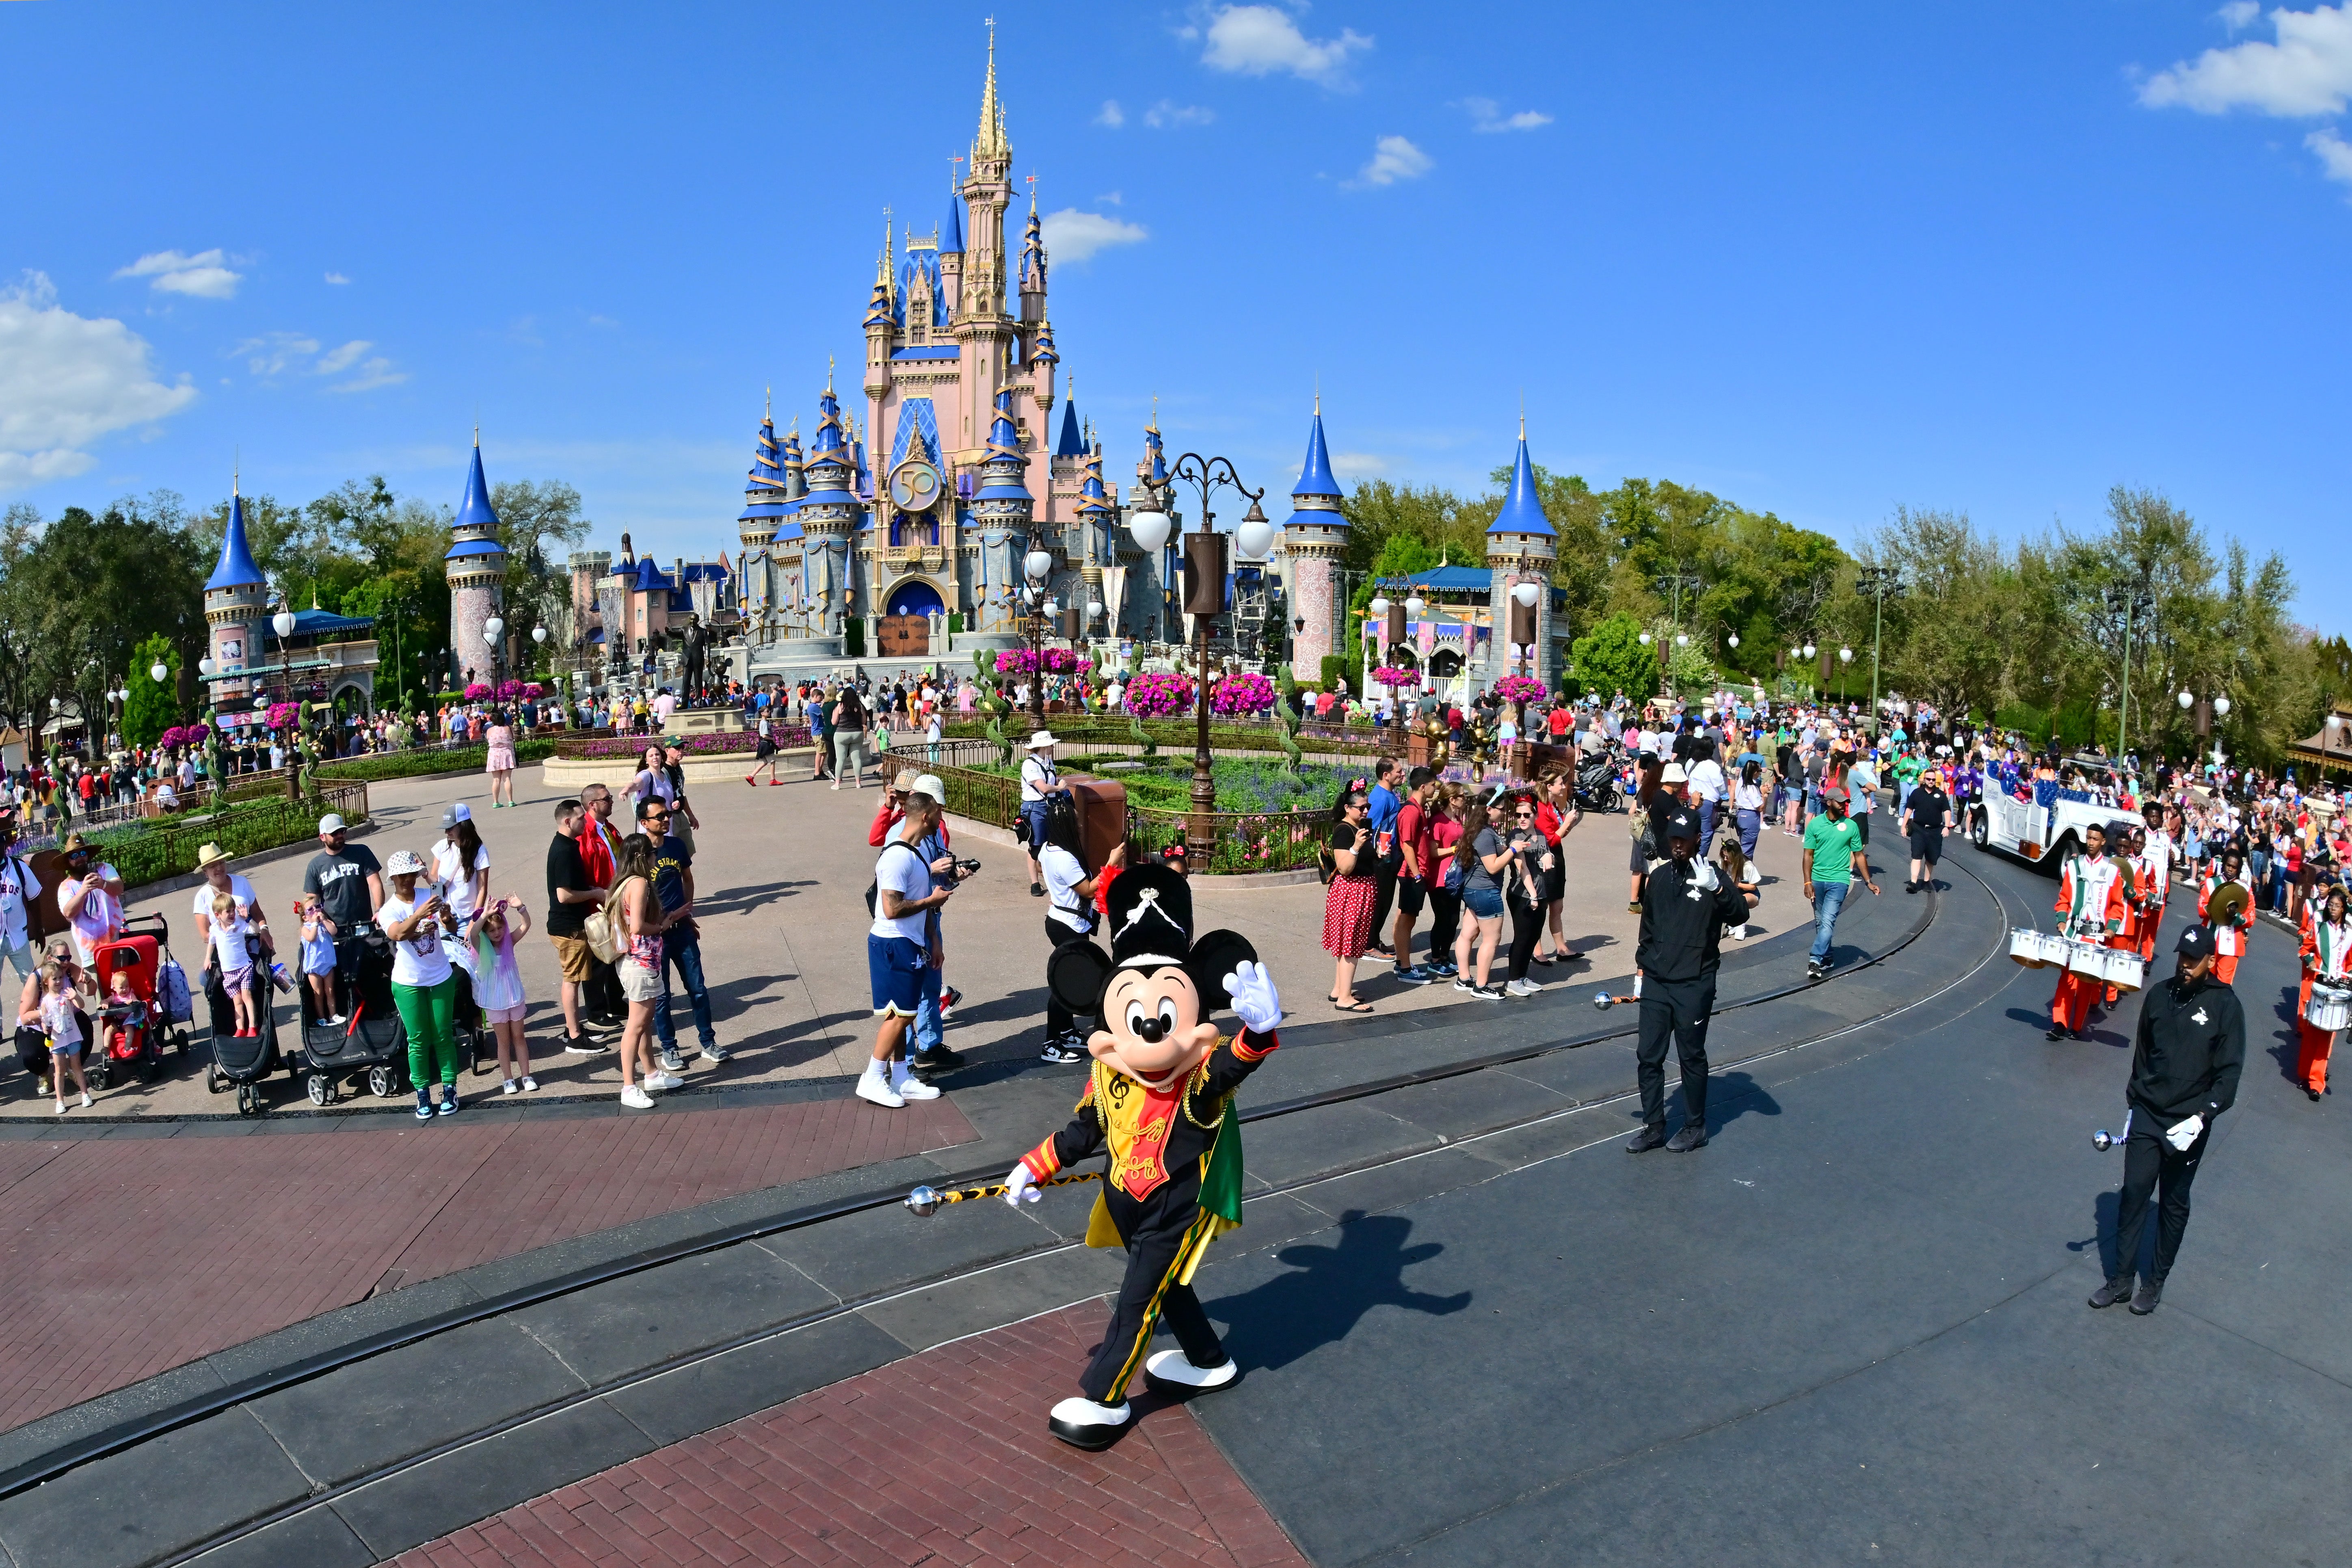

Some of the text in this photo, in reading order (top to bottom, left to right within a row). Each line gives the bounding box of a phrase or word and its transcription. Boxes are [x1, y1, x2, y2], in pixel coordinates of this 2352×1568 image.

[900, 469, 934, 505] 50
[1306, 622, 1322, 639] 50
[468, 652, 484, 668] 50
[650, 857, 682, 881] LEVI STRAUSS
[0, 884, 19, 896] ROS
